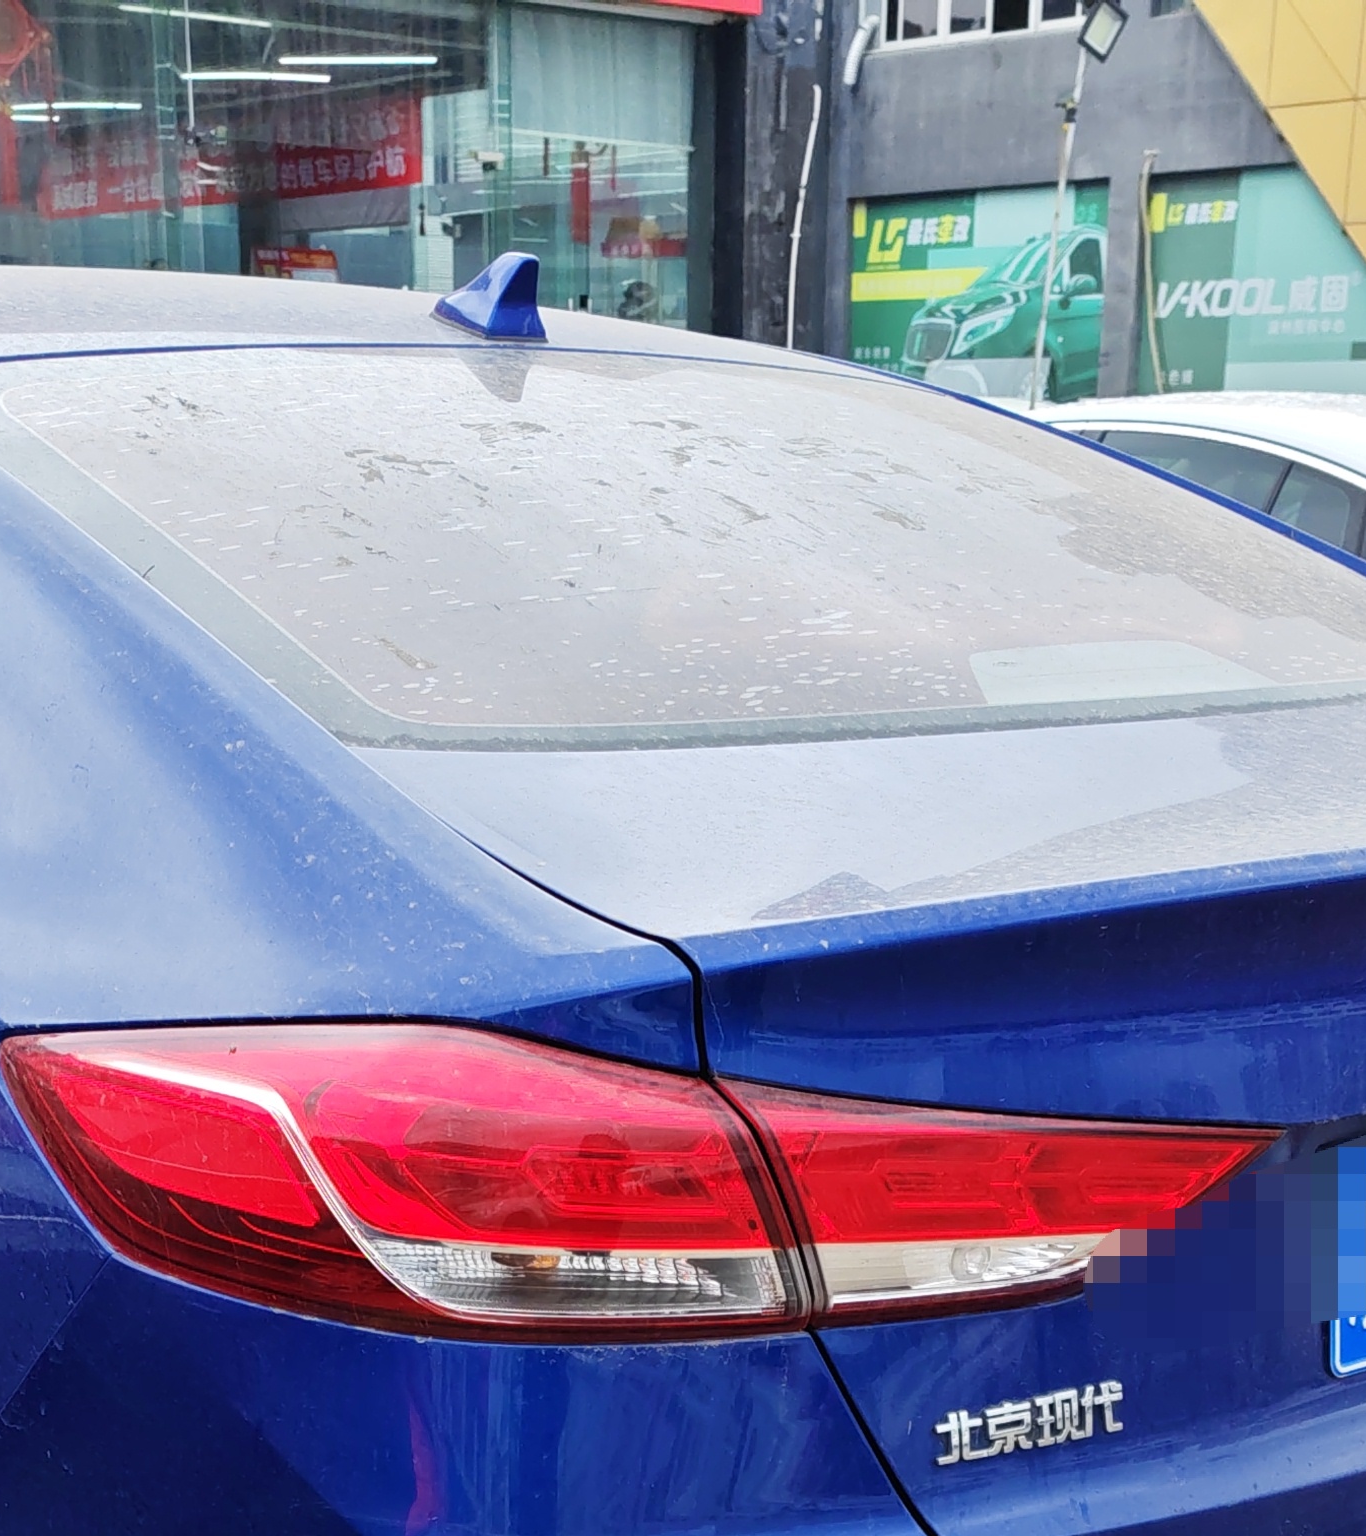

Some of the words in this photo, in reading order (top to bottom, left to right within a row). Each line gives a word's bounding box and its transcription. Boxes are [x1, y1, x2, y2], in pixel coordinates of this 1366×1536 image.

[1154, 277, 1285, 319] V-KOOL
[1288, 275, 1349, 313] 威固
[934, 1380, 1124, 1466] 北京现代
